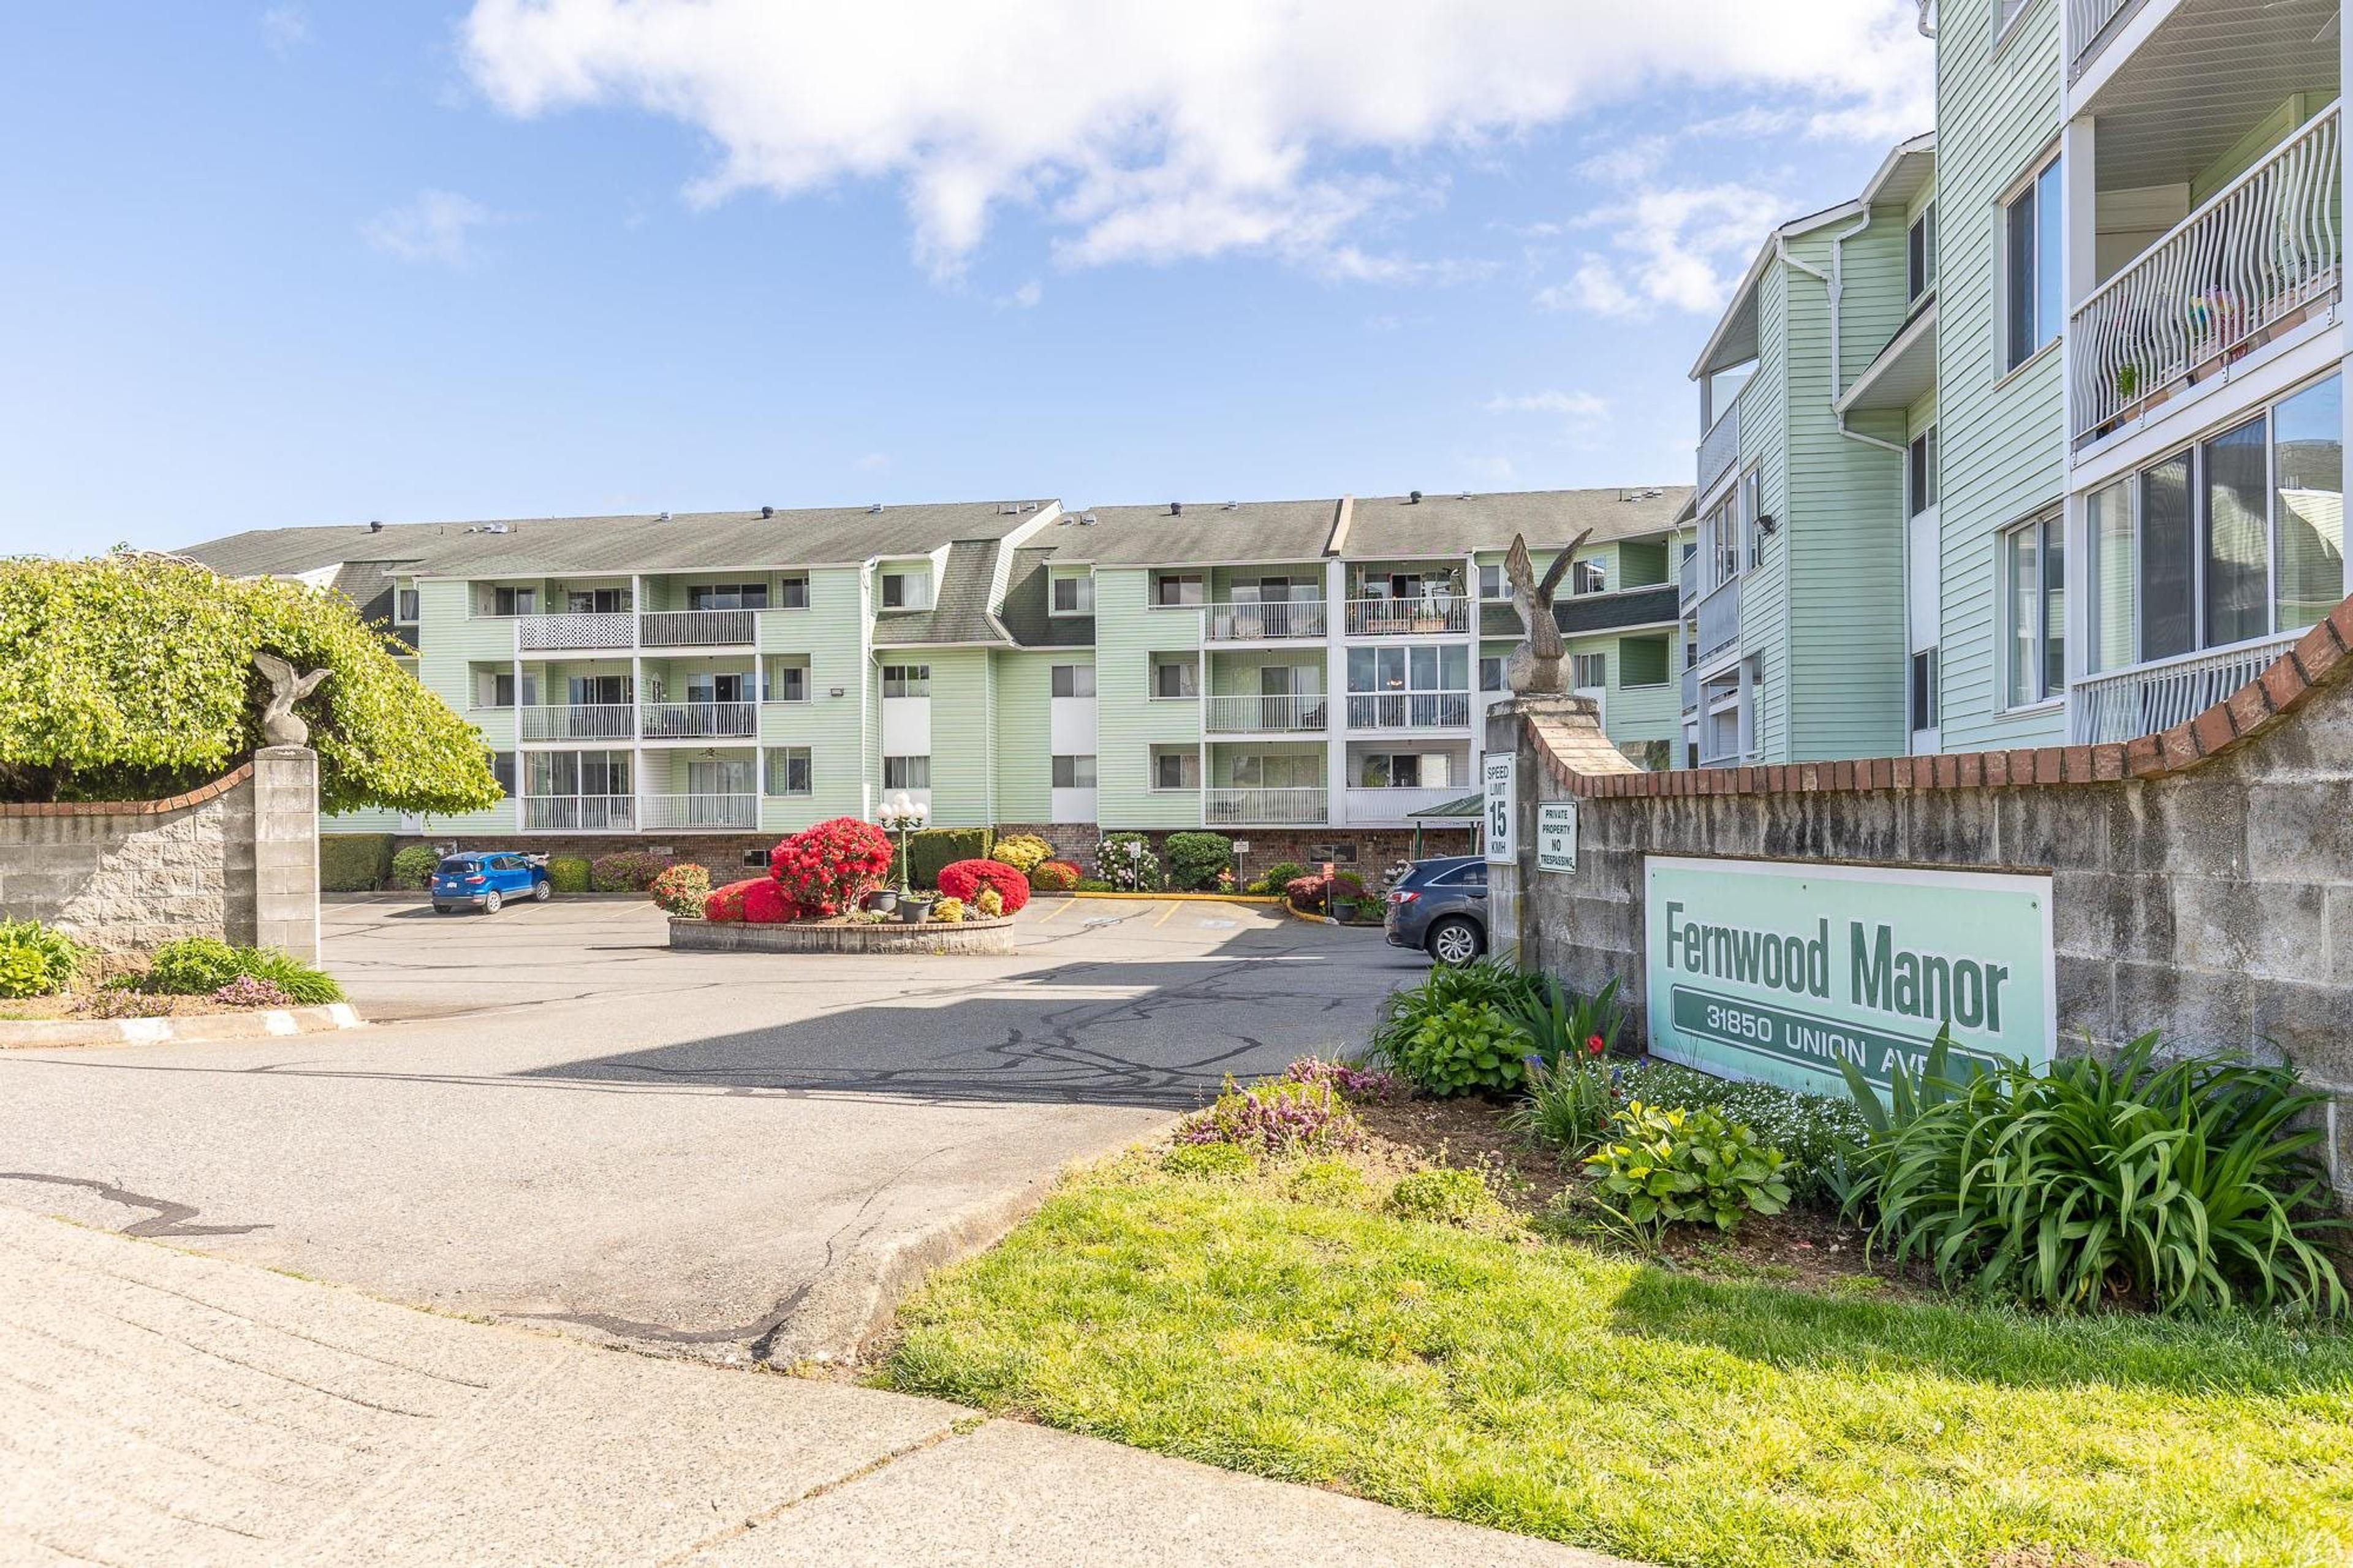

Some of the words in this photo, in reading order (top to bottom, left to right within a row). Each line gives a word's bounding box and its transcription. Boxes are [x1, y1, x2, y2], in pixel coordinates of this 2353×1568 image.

[1487, 765, 1509, 779] SPEED
[1490, 782, 1506, 796] LIMIT
[1490, 801, 1507, 837] 15
[1545, 809, 1568, 819] PRIVATE
[1542, 824, 1571, 835] PROPERTY
[1491, 841, 1506, 854] KMH
[1552, 839, 1561, 852] NO
[1540, 854, 1573, 866] TRESPASSING
[1666, 901, 1829, 998] Fernwood
[1850, 921, 2008, 1032] Manor
[1707, 1004, 1772, 1042] 31850
[1786, 1023, 1866, 1068] UNION
